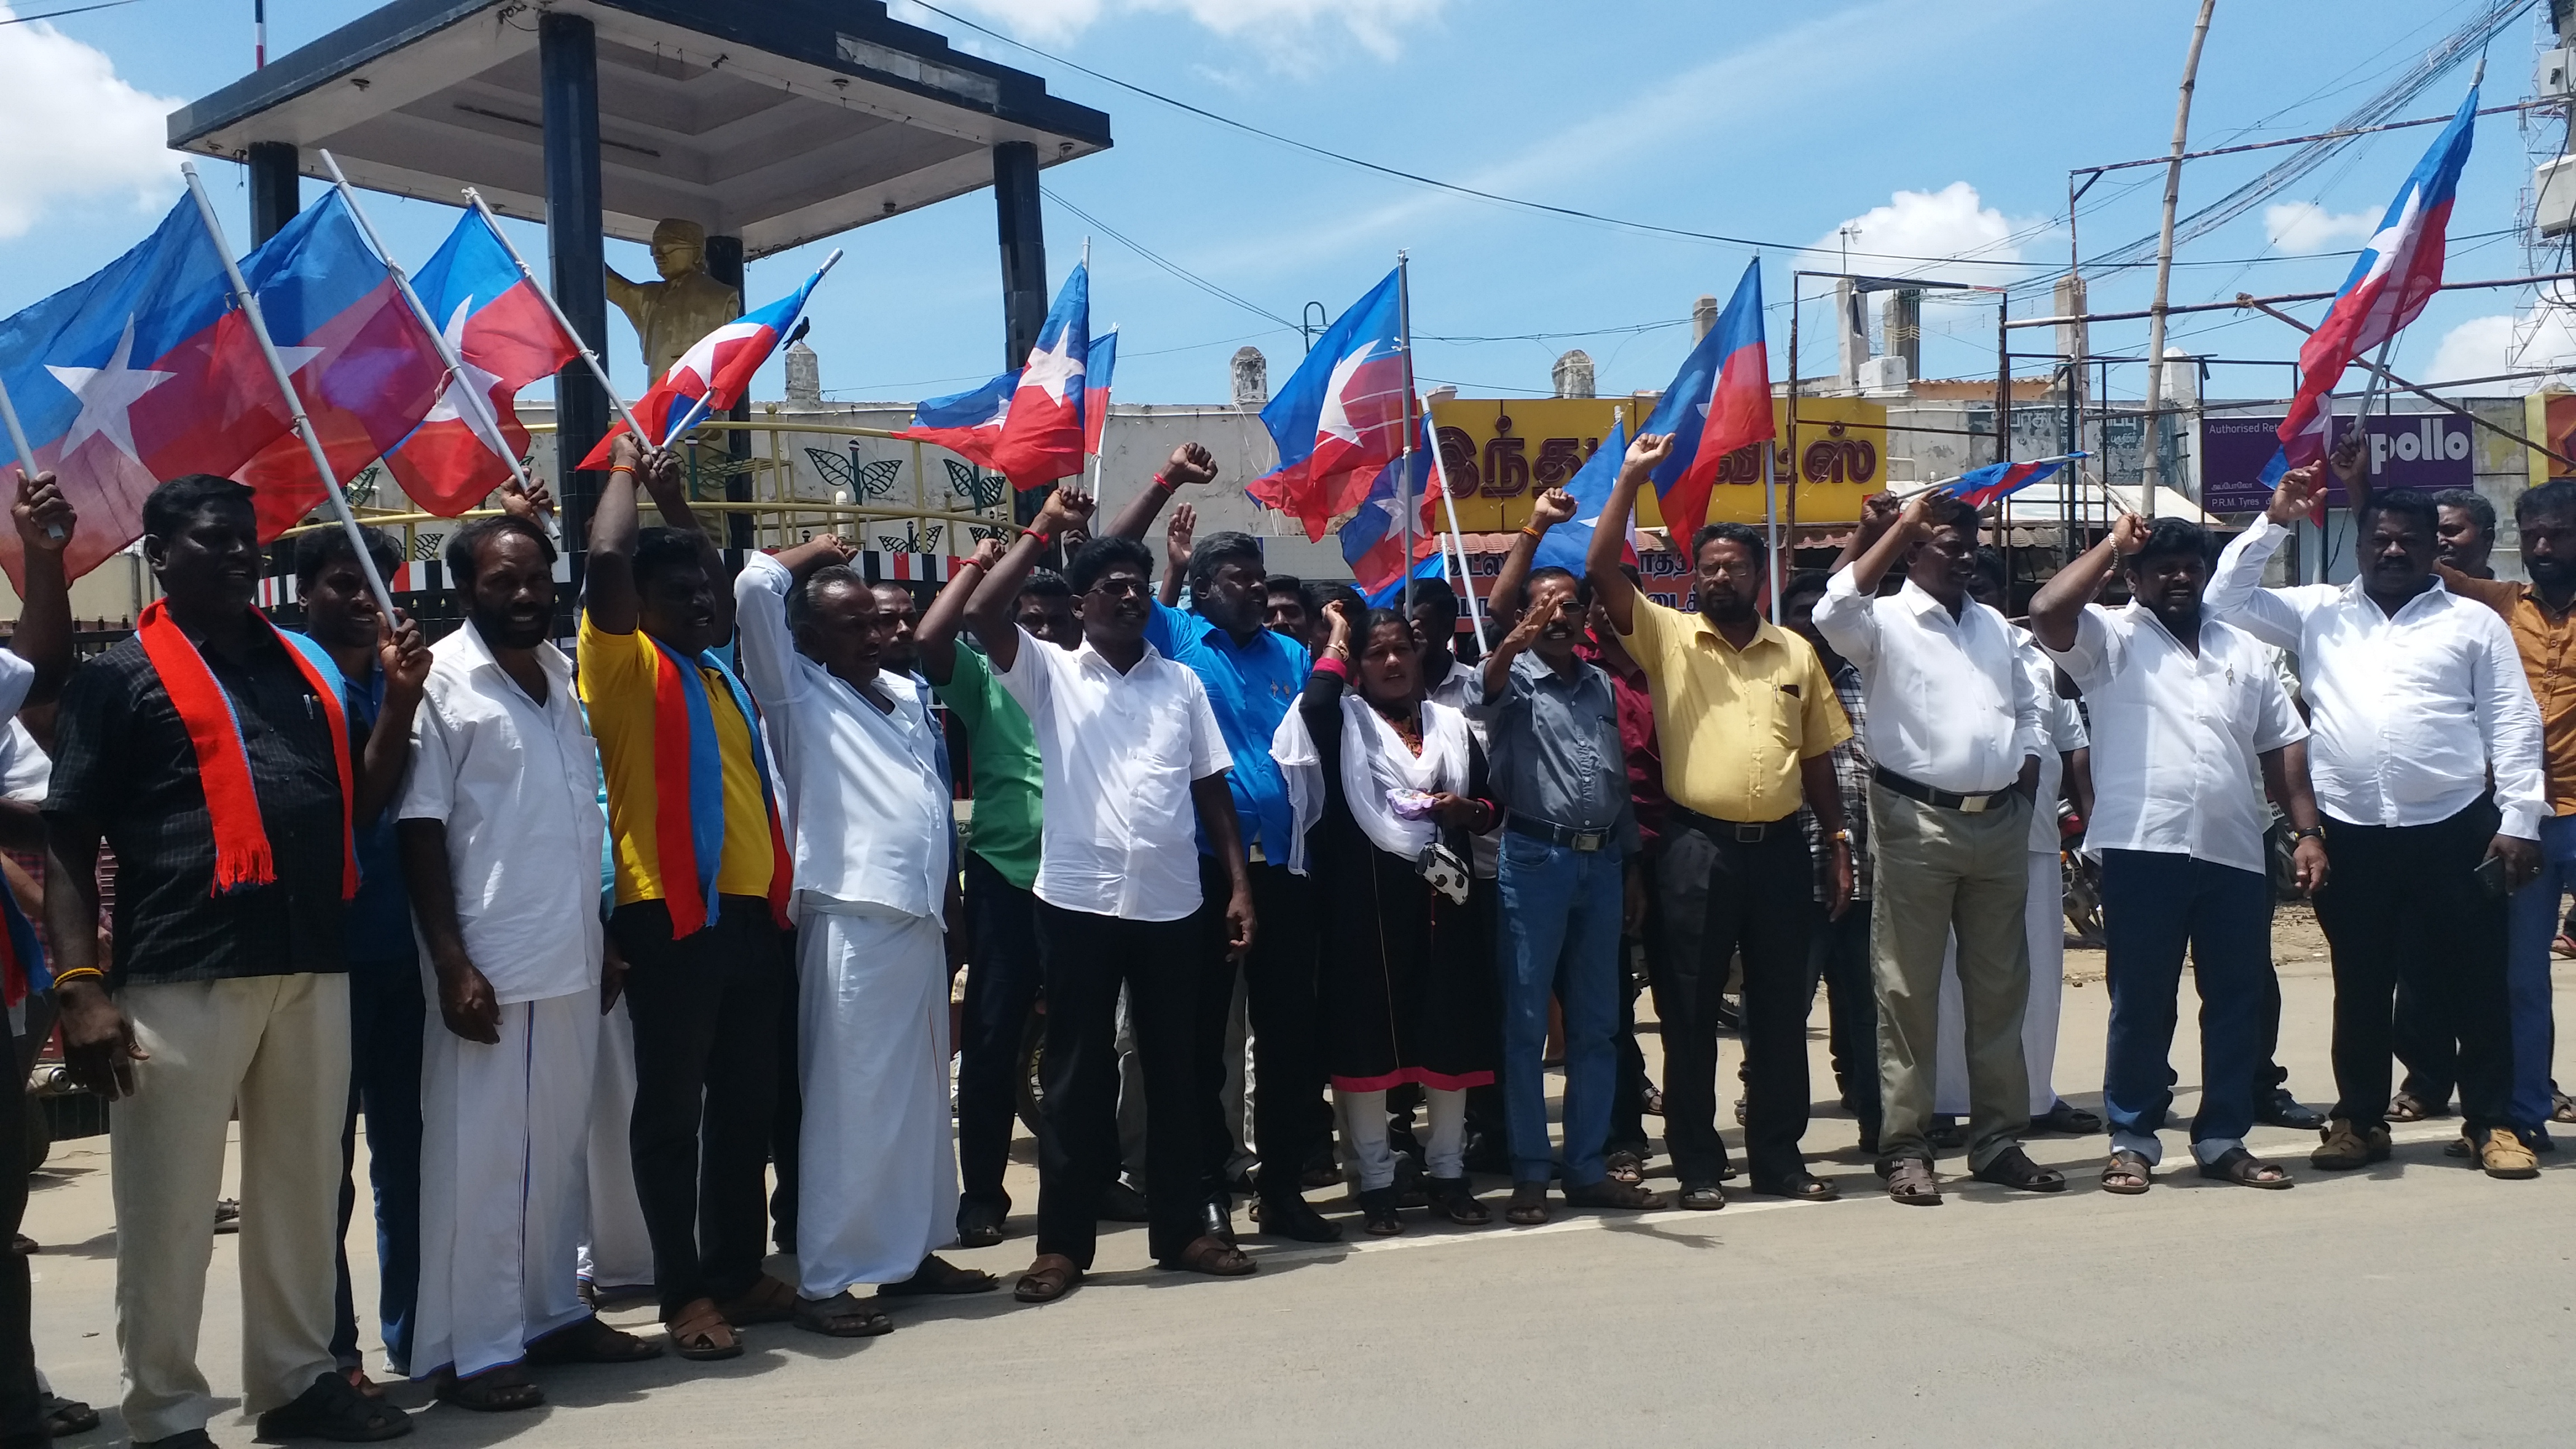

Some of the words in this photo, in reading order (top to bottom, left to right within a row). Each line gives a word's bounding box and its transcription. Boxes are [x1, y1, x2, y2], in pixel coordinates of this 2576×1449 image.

[2209, 423, 2260, 434] Authorised
[2364, 418, 2469, 475] pollo
[2238, 497, 2260, 508] Tyres
